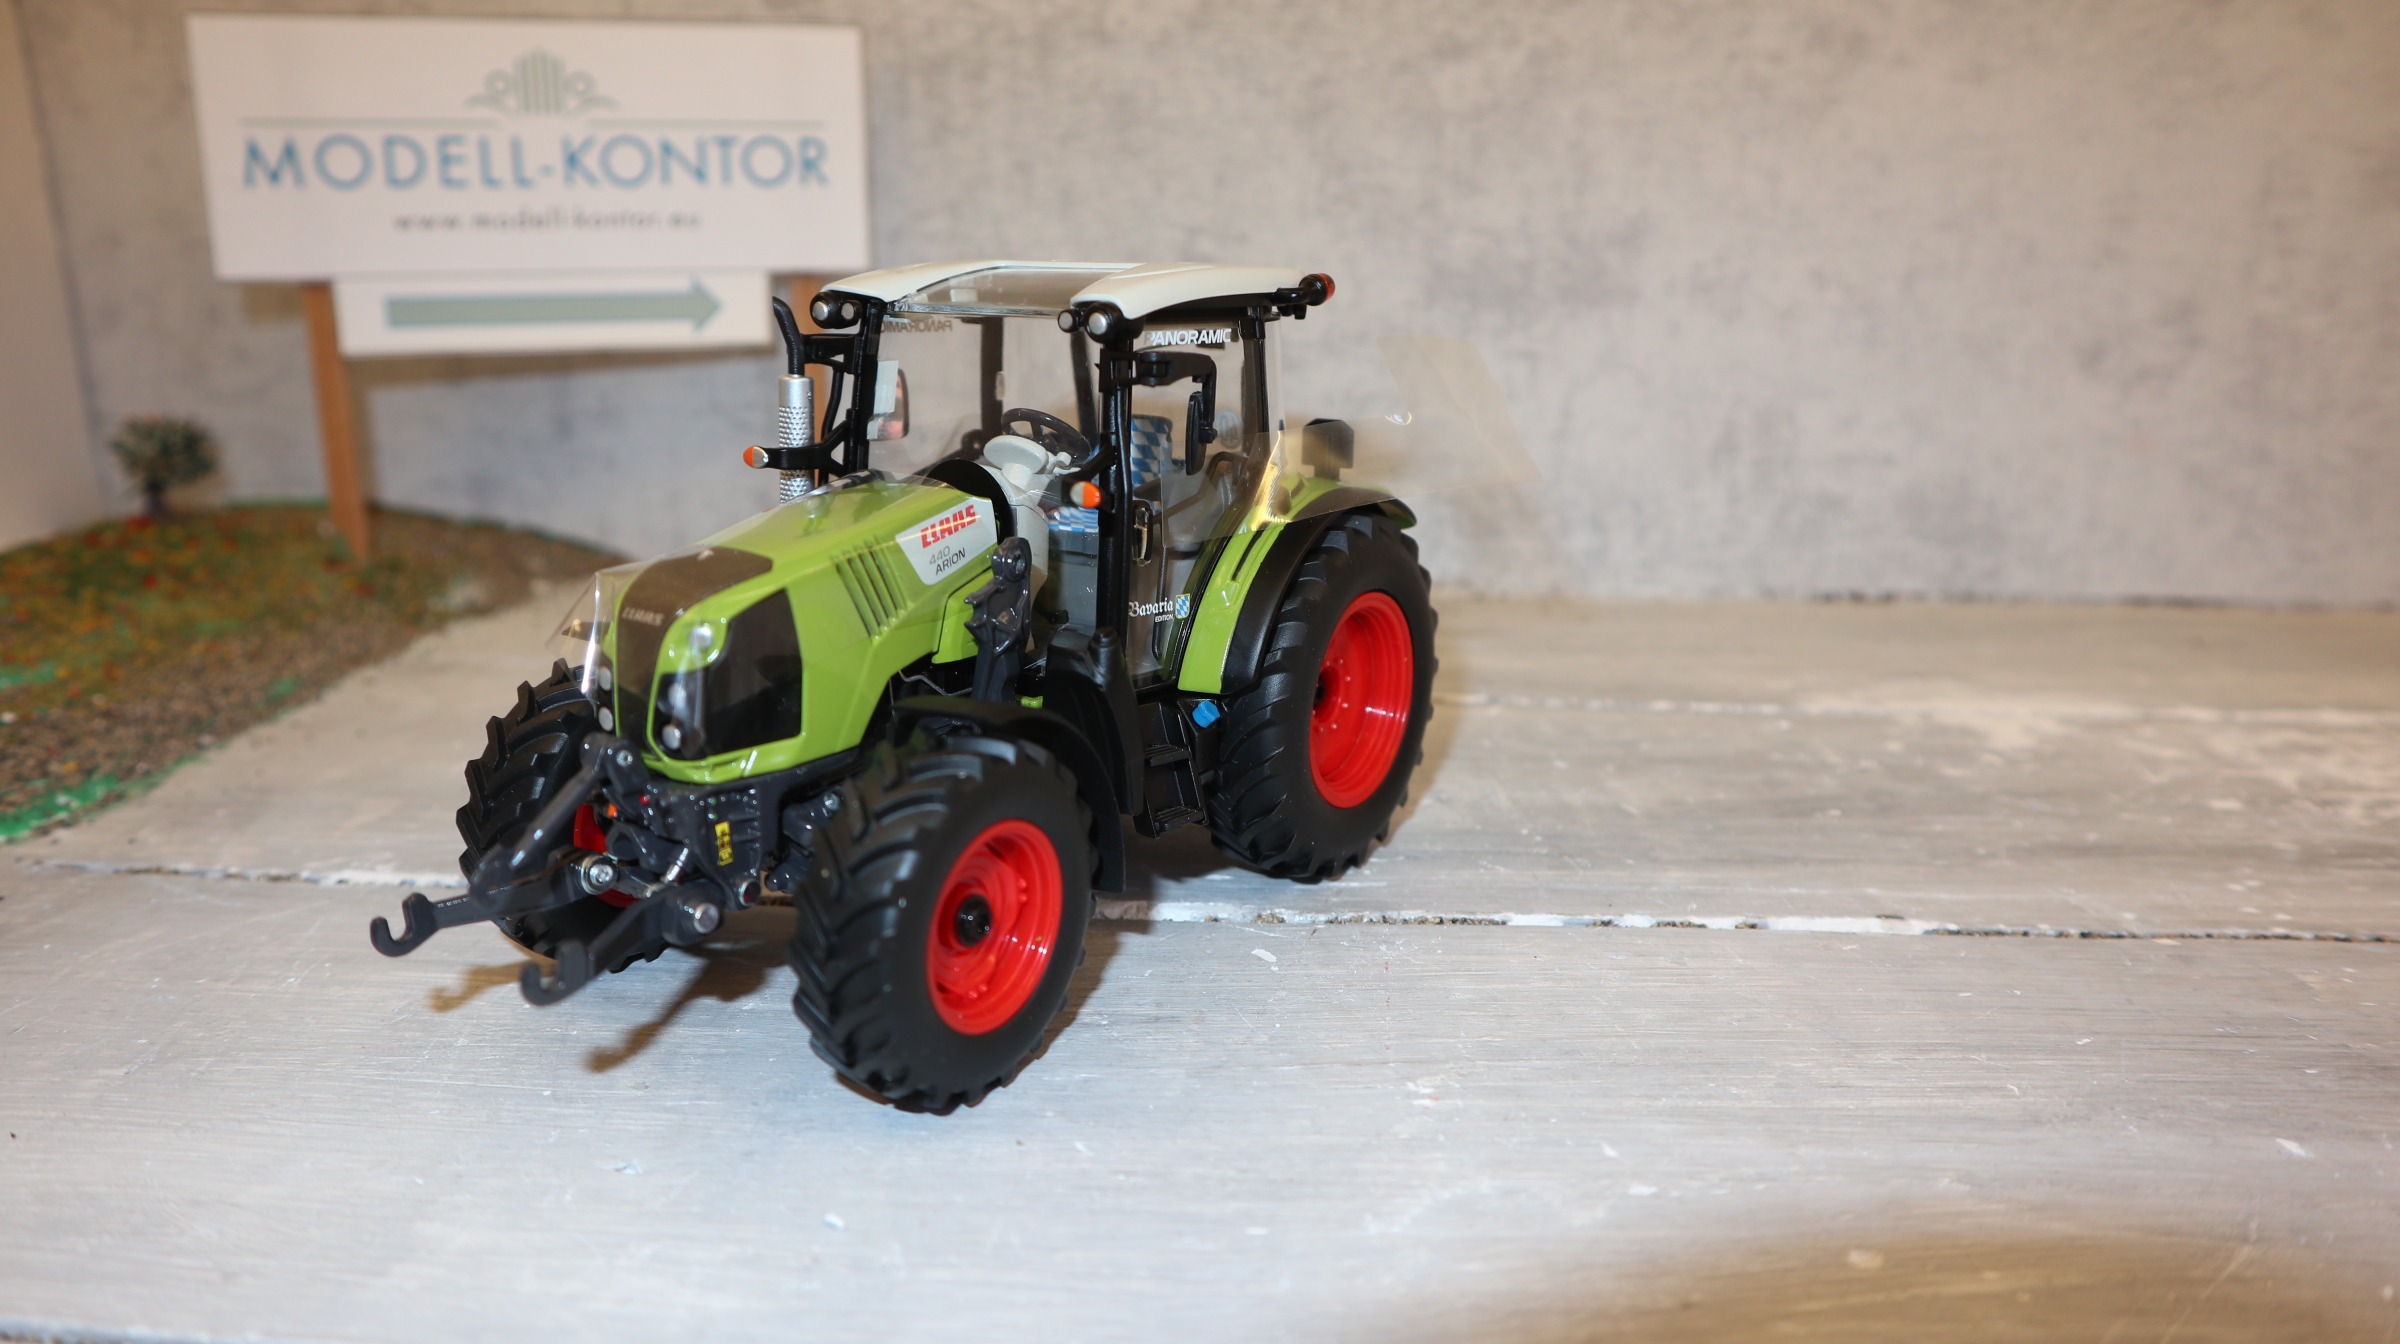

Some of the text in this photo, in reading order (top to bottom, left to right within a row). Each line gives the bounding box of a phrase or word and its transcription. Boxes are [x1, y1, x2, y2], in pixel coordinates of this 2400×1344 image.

[243, 134, 830, 190] MODELL-KONTOR
[1143, 328, 1232, 346] PANORAMIC
[920, 504, 977, 549] CLAAS
[929, 545, 951, 566] 440
[935, 547, 966, 576] ARION
[1128, 597, 1174, 617] Bavaria
[1154, 613, 1174, 623] EDITION
